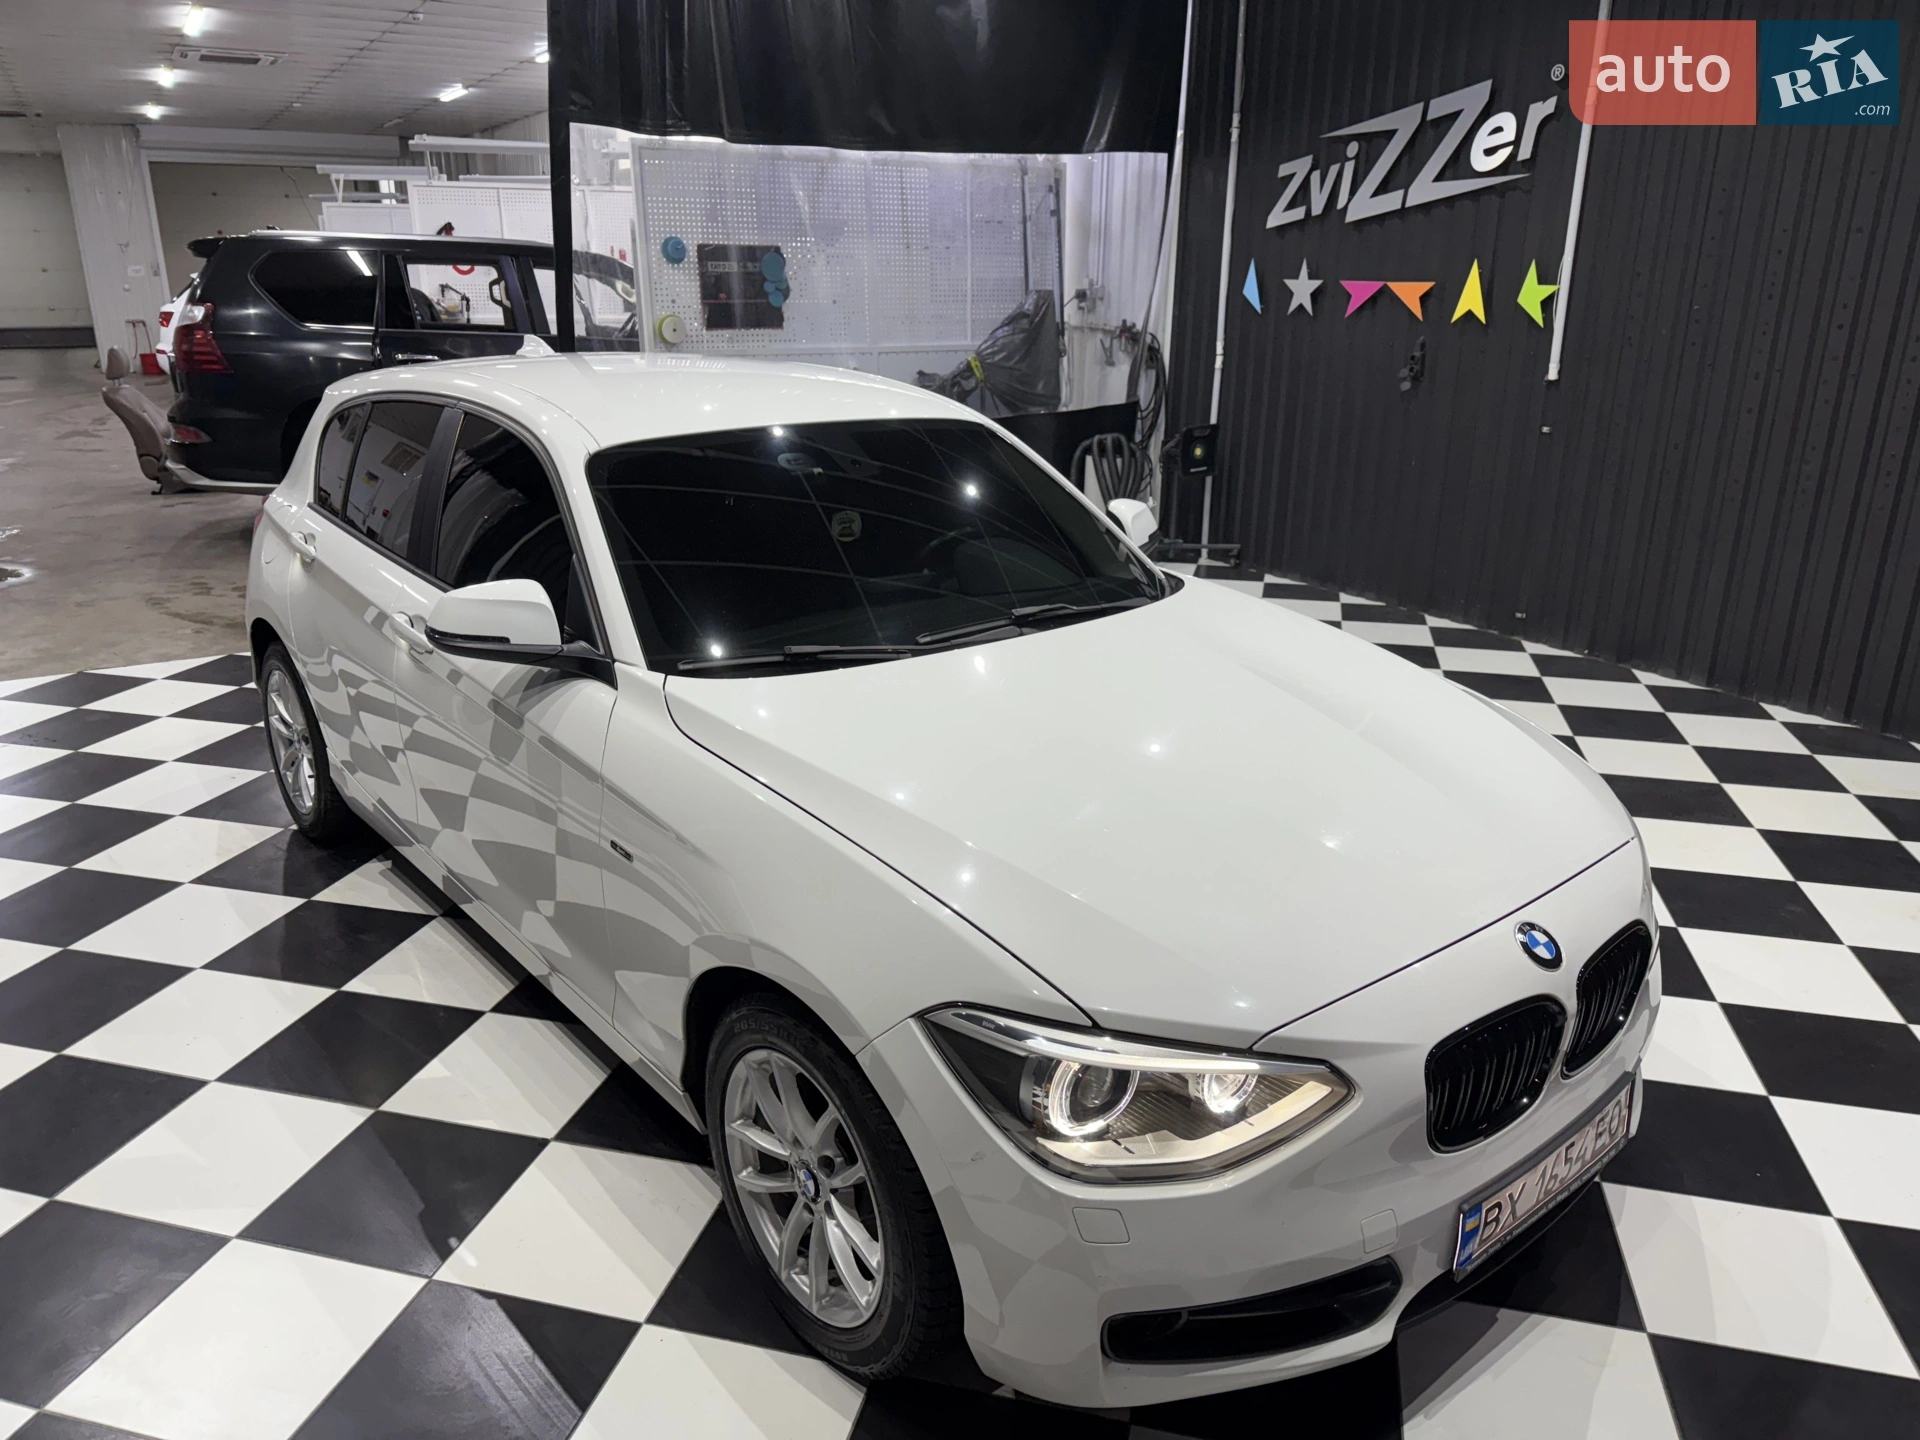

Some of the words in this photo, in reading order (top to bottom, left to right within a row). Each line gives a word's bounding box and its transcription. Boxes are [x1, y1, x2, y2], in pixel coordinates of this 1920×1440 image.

[1479, 1181, 1527, 1242] BX
[1534, 1129, 1590, 1203] 1654
[1591, 1098, 1623, 1154] EO
